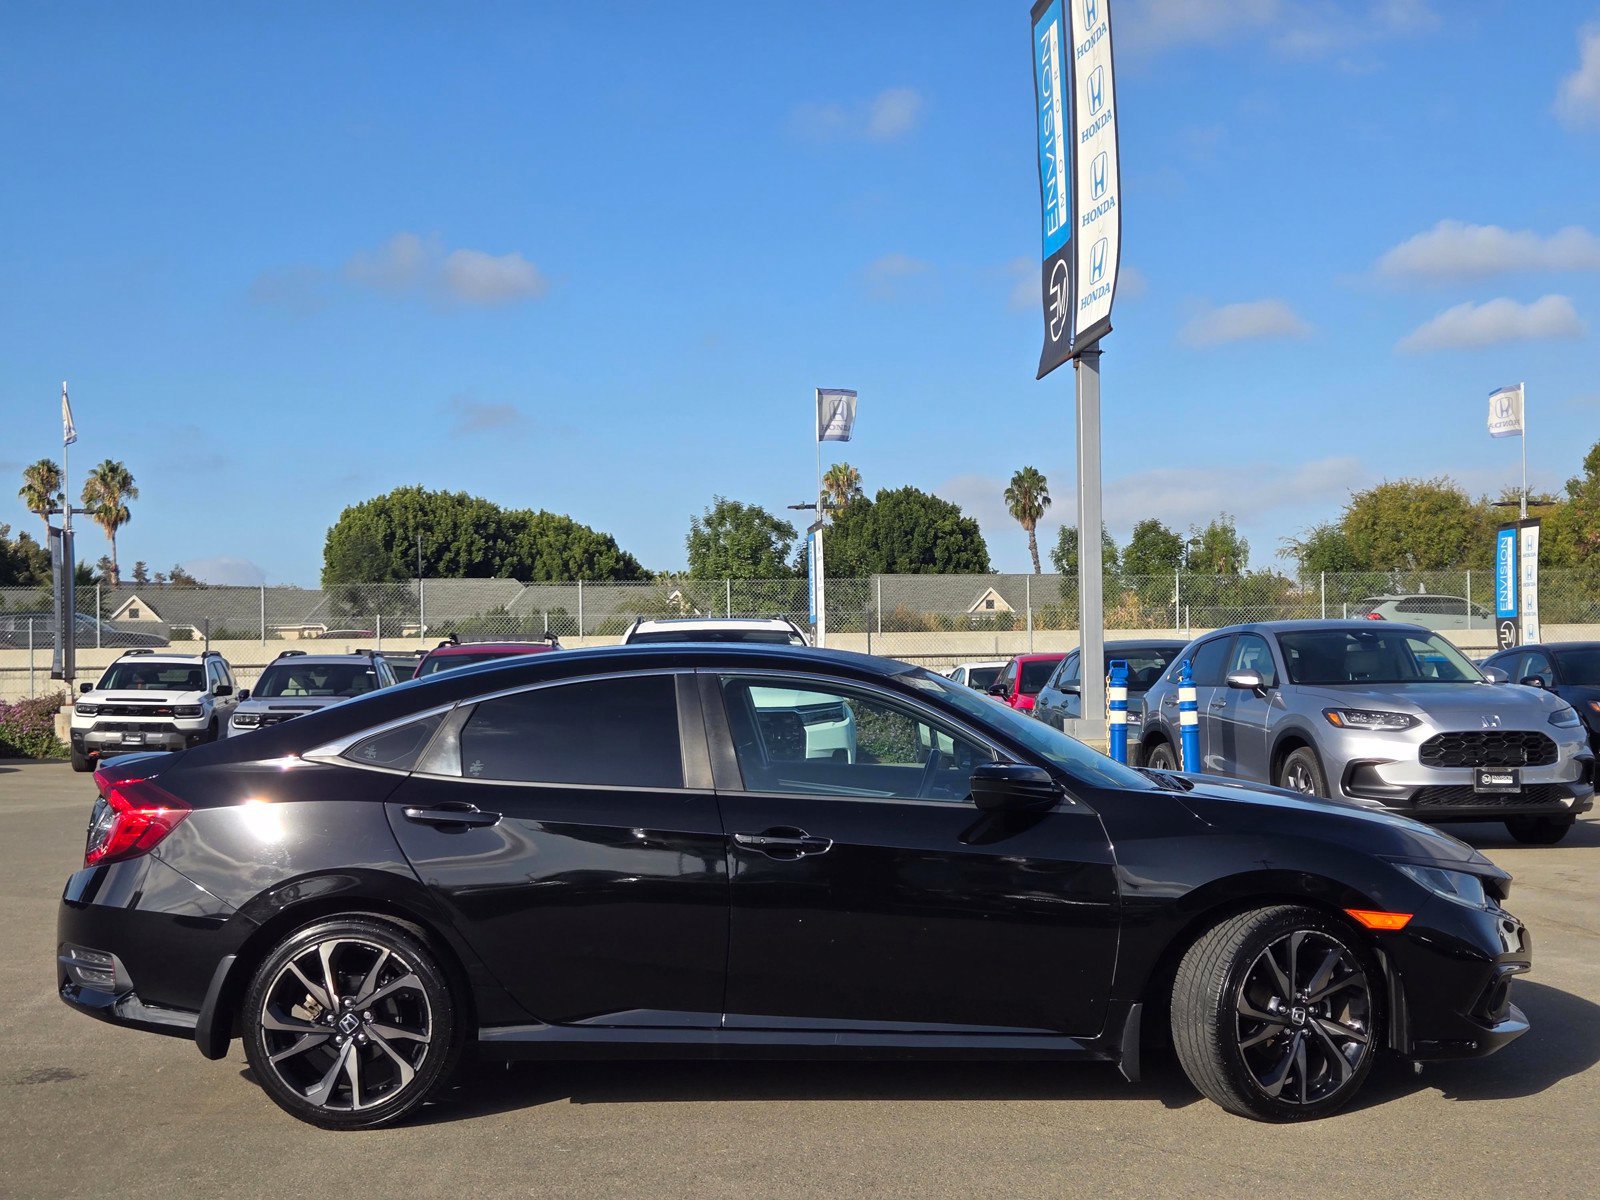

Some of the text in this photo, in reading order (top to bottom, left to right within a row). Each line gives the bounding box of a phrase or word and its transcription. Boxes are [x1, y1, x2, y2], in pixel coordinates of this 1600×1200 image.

[1076, 22, 1108, 60] HONDA
[1040, 30, 1058, 236] ENVISION
[1053, 41, 1065, 208] MOTORS
[1081, 109, 1113, 143] HONDA
[1081, 196, 1116, 228] HONDA
[1080, 282, 1111, 311] HONDA
[1500, 537, 1508, 611] ENVISION
